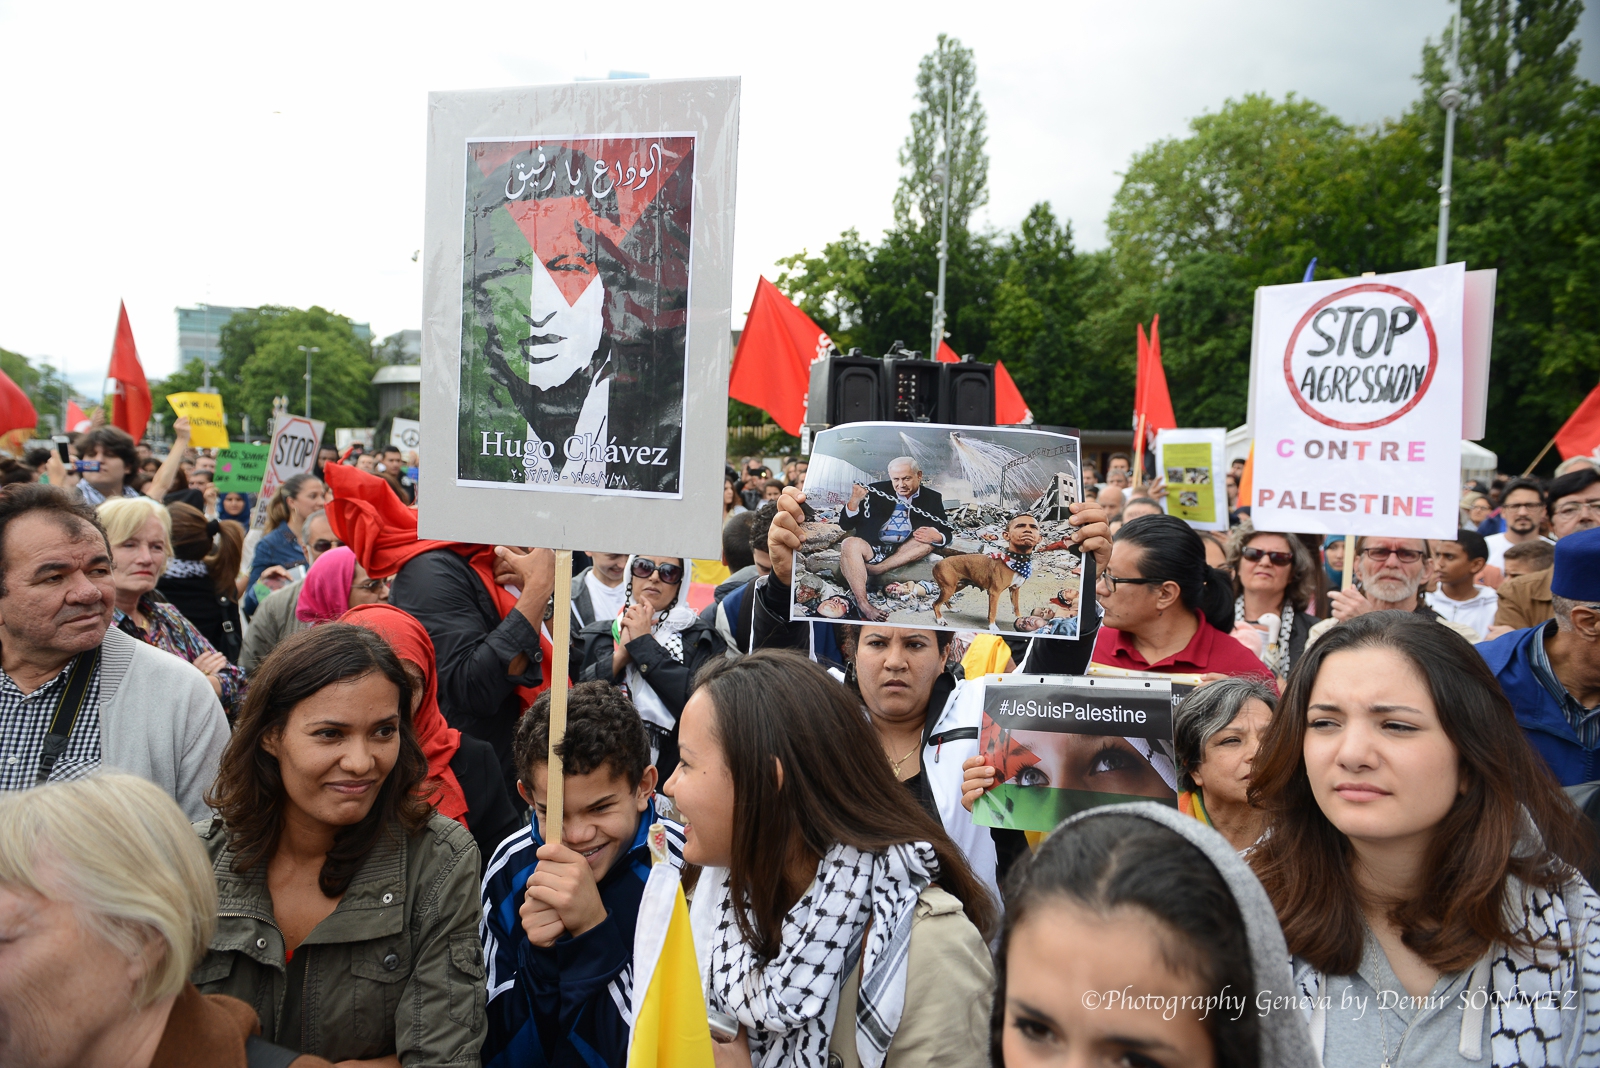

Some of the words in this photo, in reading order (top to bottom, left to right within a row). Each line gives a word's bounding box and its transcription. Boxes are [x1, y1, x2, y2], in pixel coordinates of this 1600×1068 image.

[505, 145, 557, 200] رفيق
[565, 159, 585, 196] يا
[592, 143, 662, 199] الوداع
[1306, 305, 1419, 359] STOP
[275, 434, 314, 468] STOP
[480, 430, 555, 468] Hugo
[563, 432, 668, 466] Chávez
[1276, 438, 1426, 462] CONTRE
[1258, 488, 1434, 517] PALESTINE
[999, 699, 1147, 724] #JeSuisPalestine
